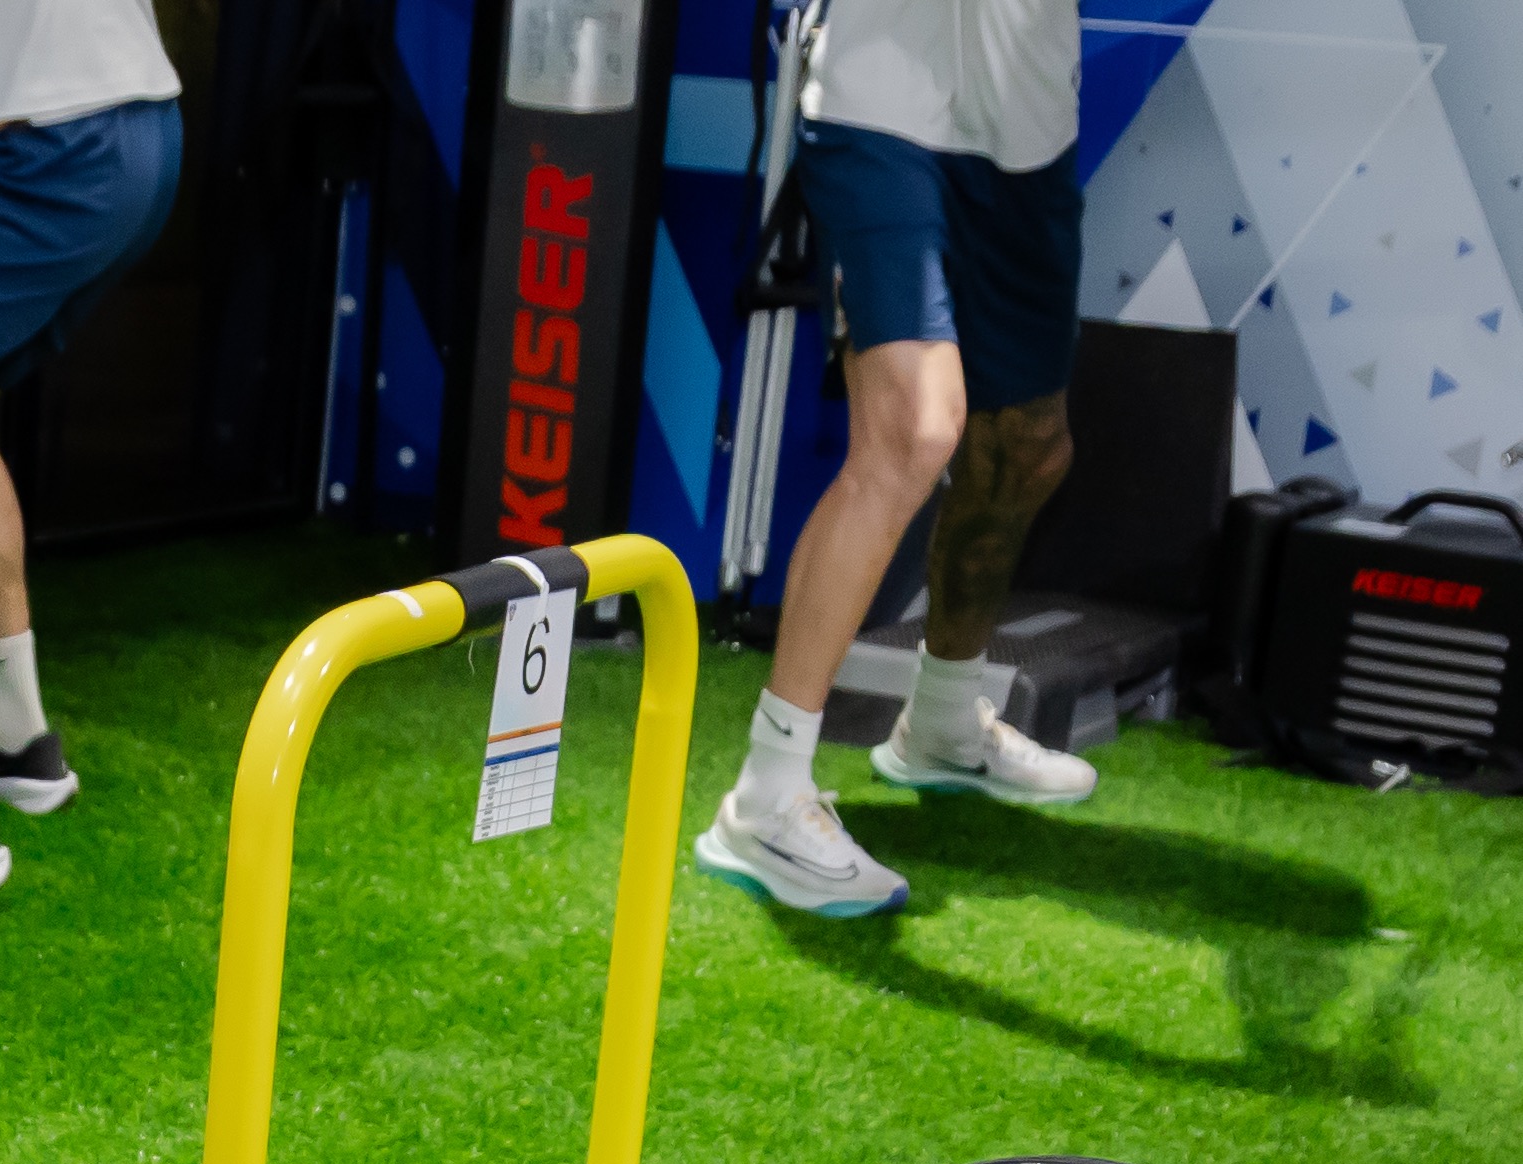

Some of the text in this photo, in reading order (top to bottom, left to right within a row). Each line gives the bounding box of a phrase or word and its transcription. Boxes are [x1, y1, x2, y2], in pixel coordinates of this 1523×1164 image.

[498, 163, 594, 548] KEISER
[1352, 568, 1484, 610] KEISER
[522, 616, 550, 695] 6
